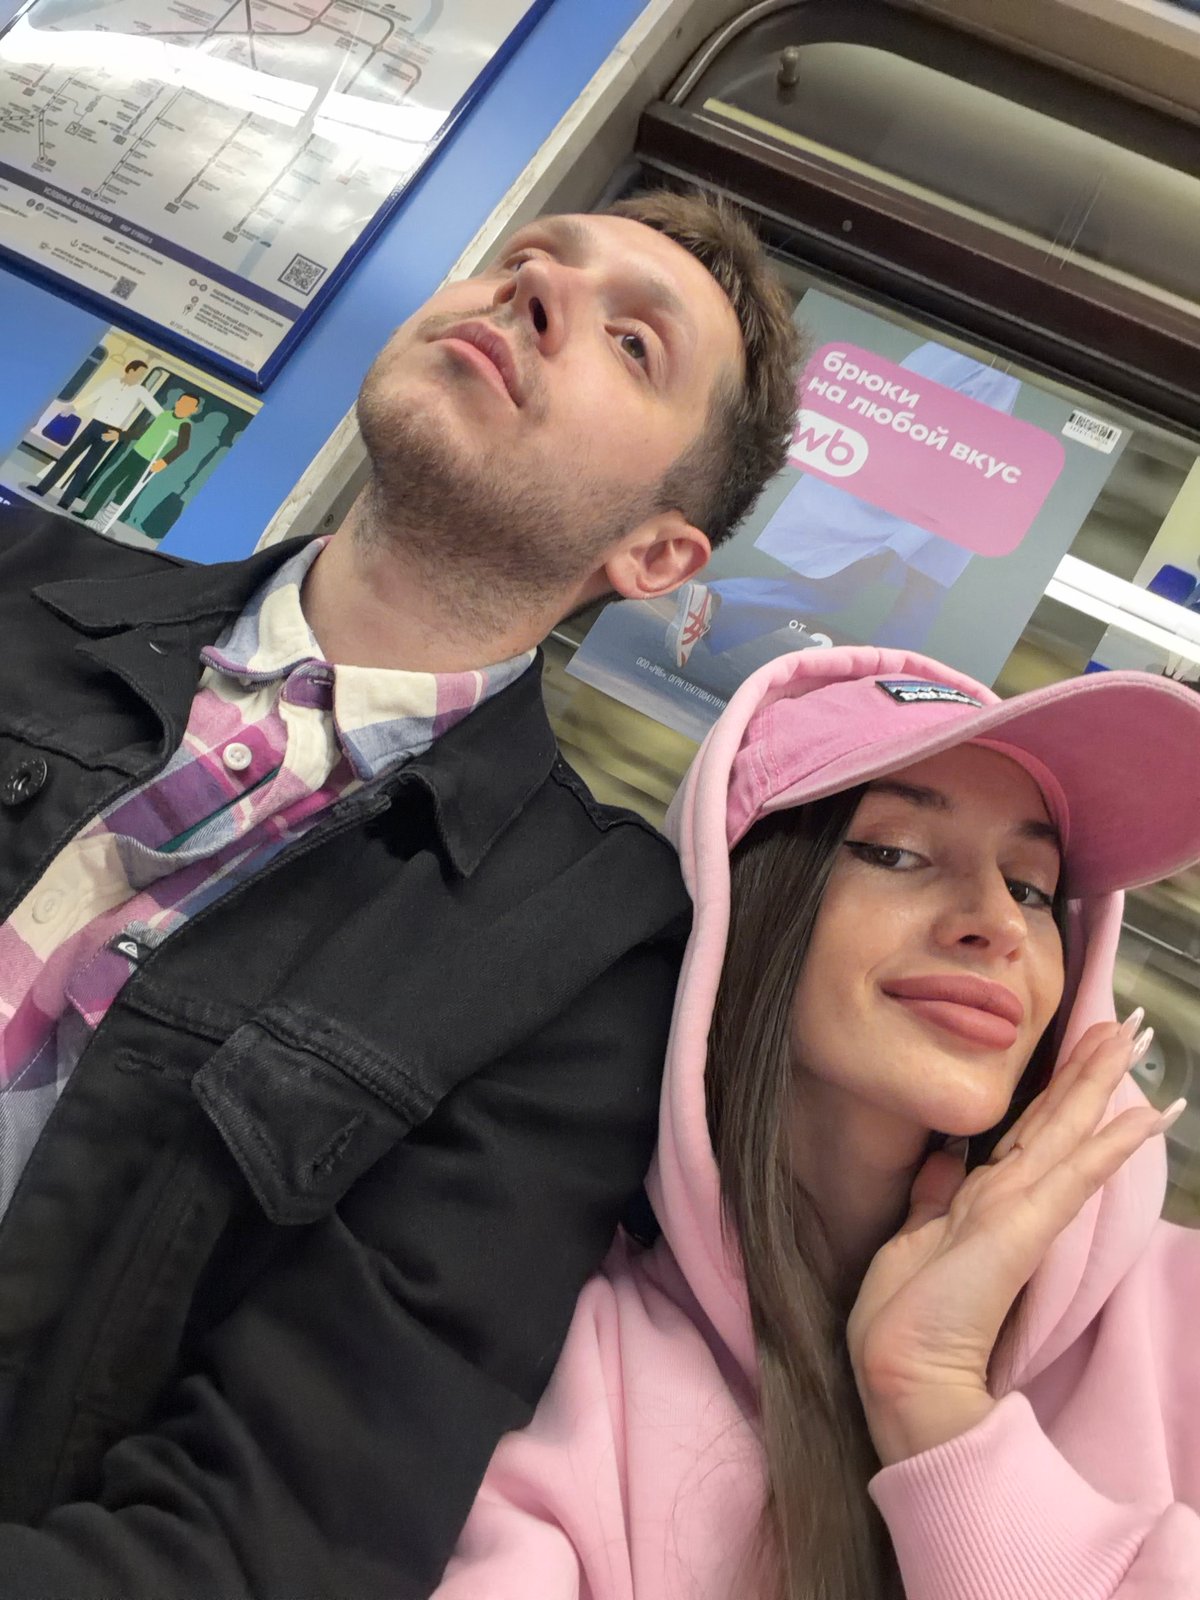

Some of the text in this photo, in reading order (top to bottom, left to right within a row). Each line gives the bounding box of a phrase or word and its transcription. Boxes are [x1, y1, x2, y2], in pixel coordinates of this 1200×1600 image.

[823, 350, 920, 409] брюки
[793, 420, 855, 466] wb
[807, 376, 1022, 484] на любой вкус
